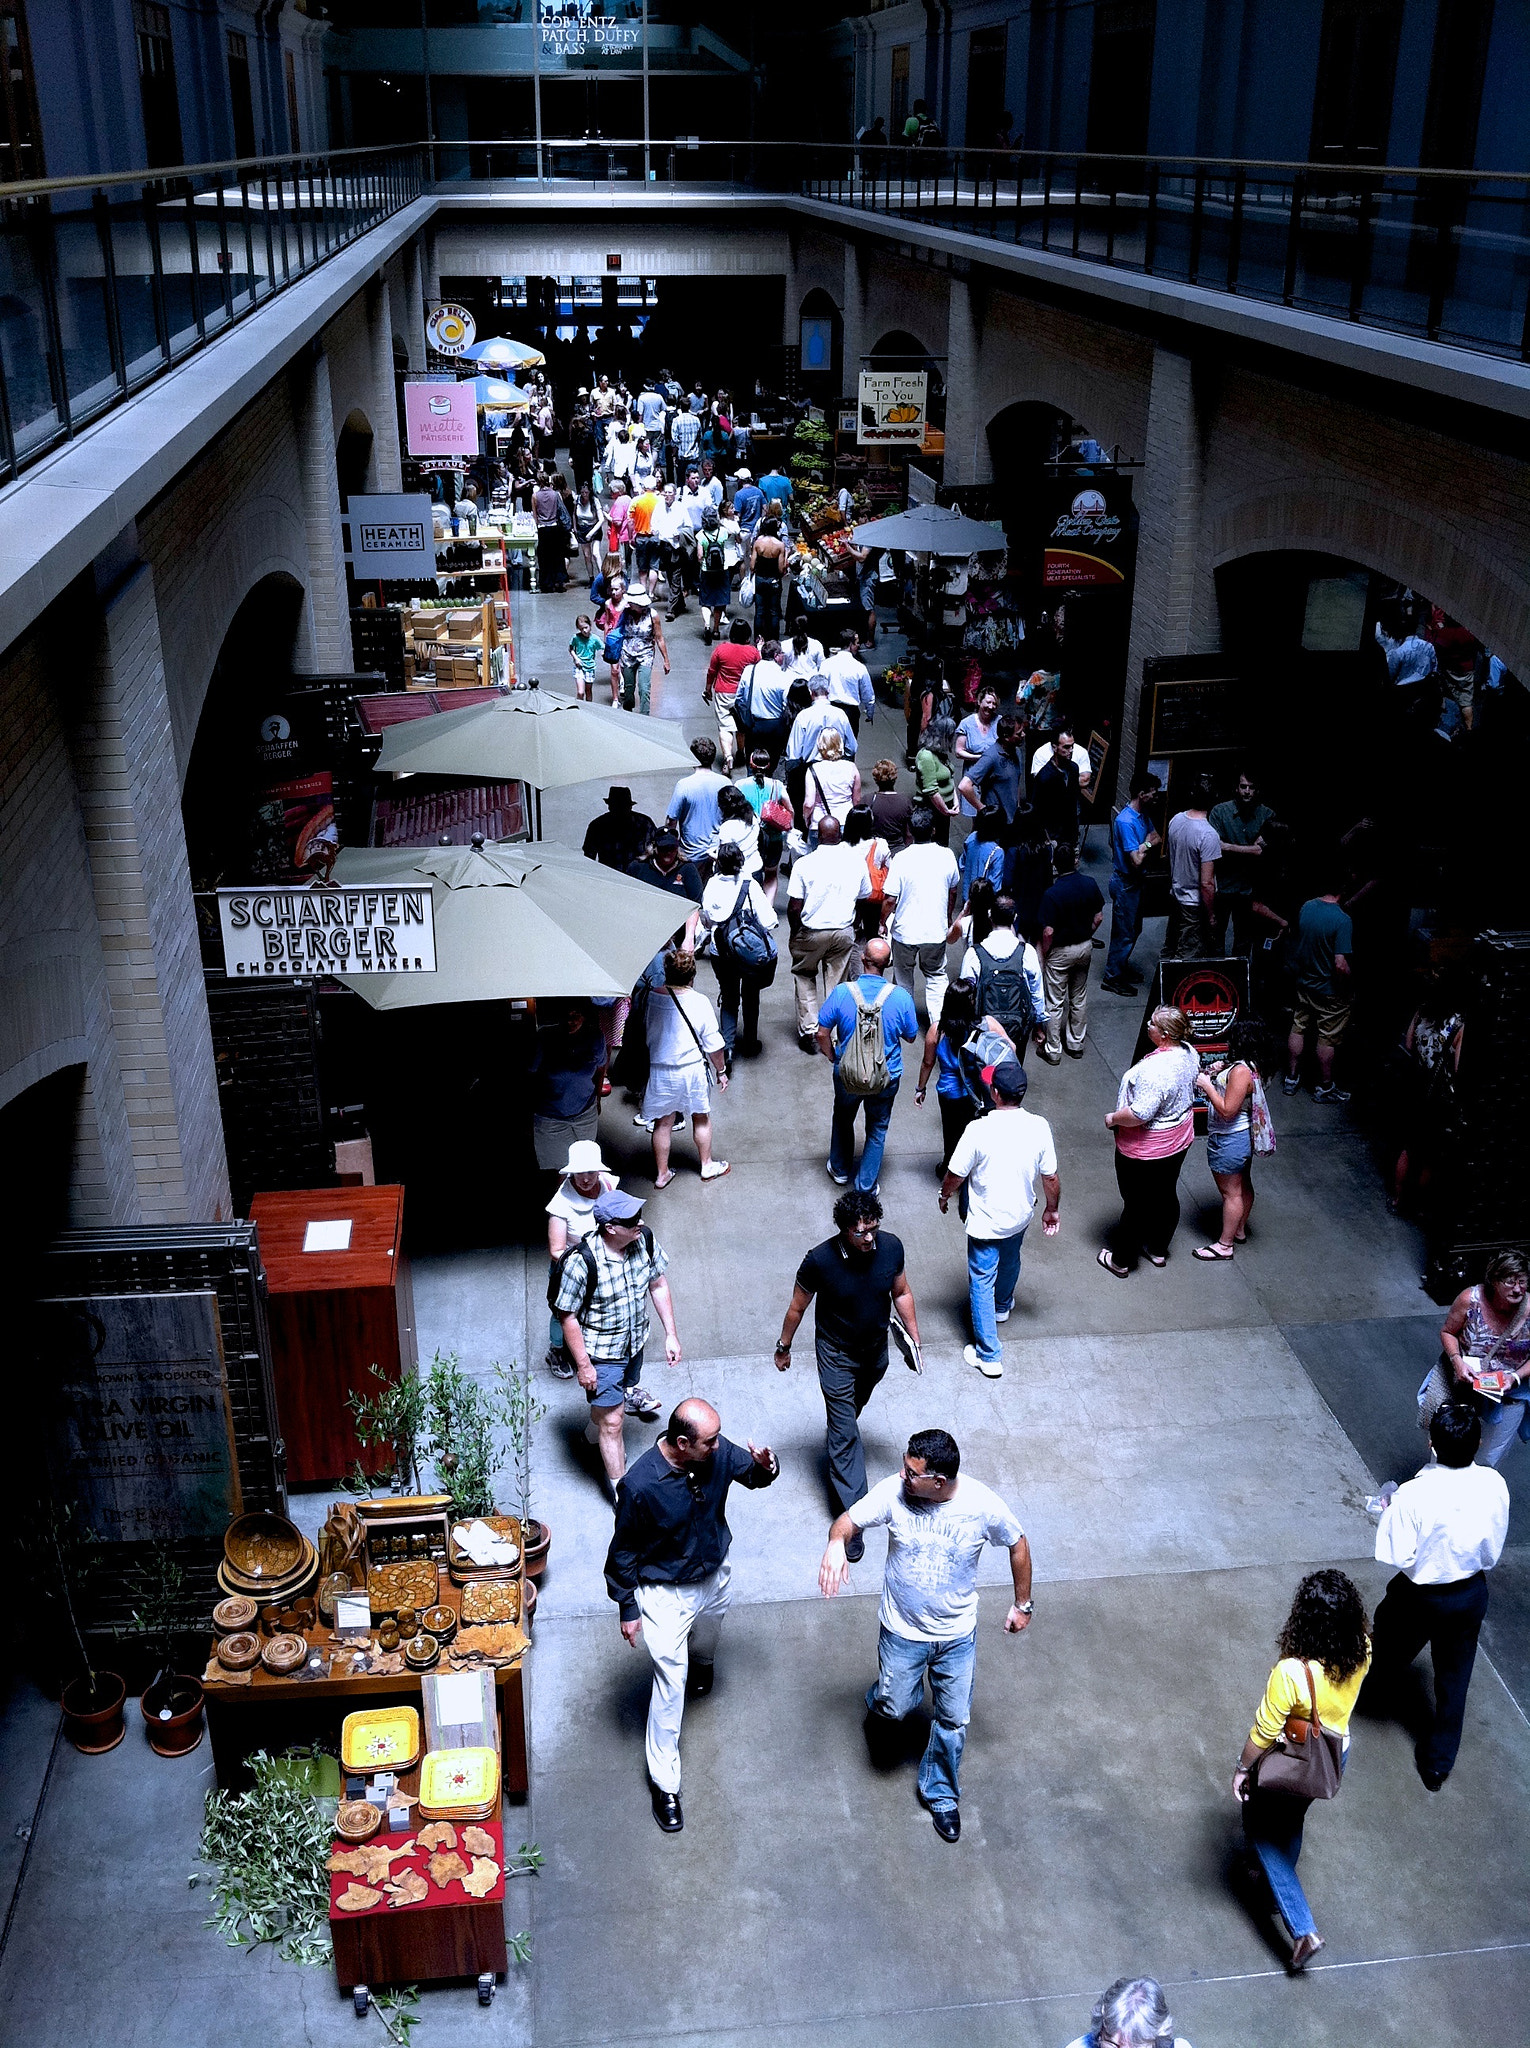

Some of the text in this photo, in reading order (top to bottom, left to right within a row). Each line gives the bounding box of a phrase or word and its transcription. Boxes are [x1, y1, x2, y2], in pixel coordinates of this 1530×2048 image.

[542, 29, 640, 43] PATCH, DUFFY
[542, 42, 585, 55] & BASS
[863, 375, 924, 388] Farm Fresh
[873, 389, 914, 401] To You
[420, 417, 466, 432] miette
[364, 527, 420, 540] HEATH
[366, 540, 421, 548] CERAMICS
[263, 750, 292, 760] BERGER
[229, 892, 425, 927] SCHARFFEN
[262, 926, 398, 959] BERGER
[236, 957, 423, 974] CHOCOLATE MAKER
[130, 1394, 217, 1415] VIRGIN
[155, 1419, 195, 1439] OIL
